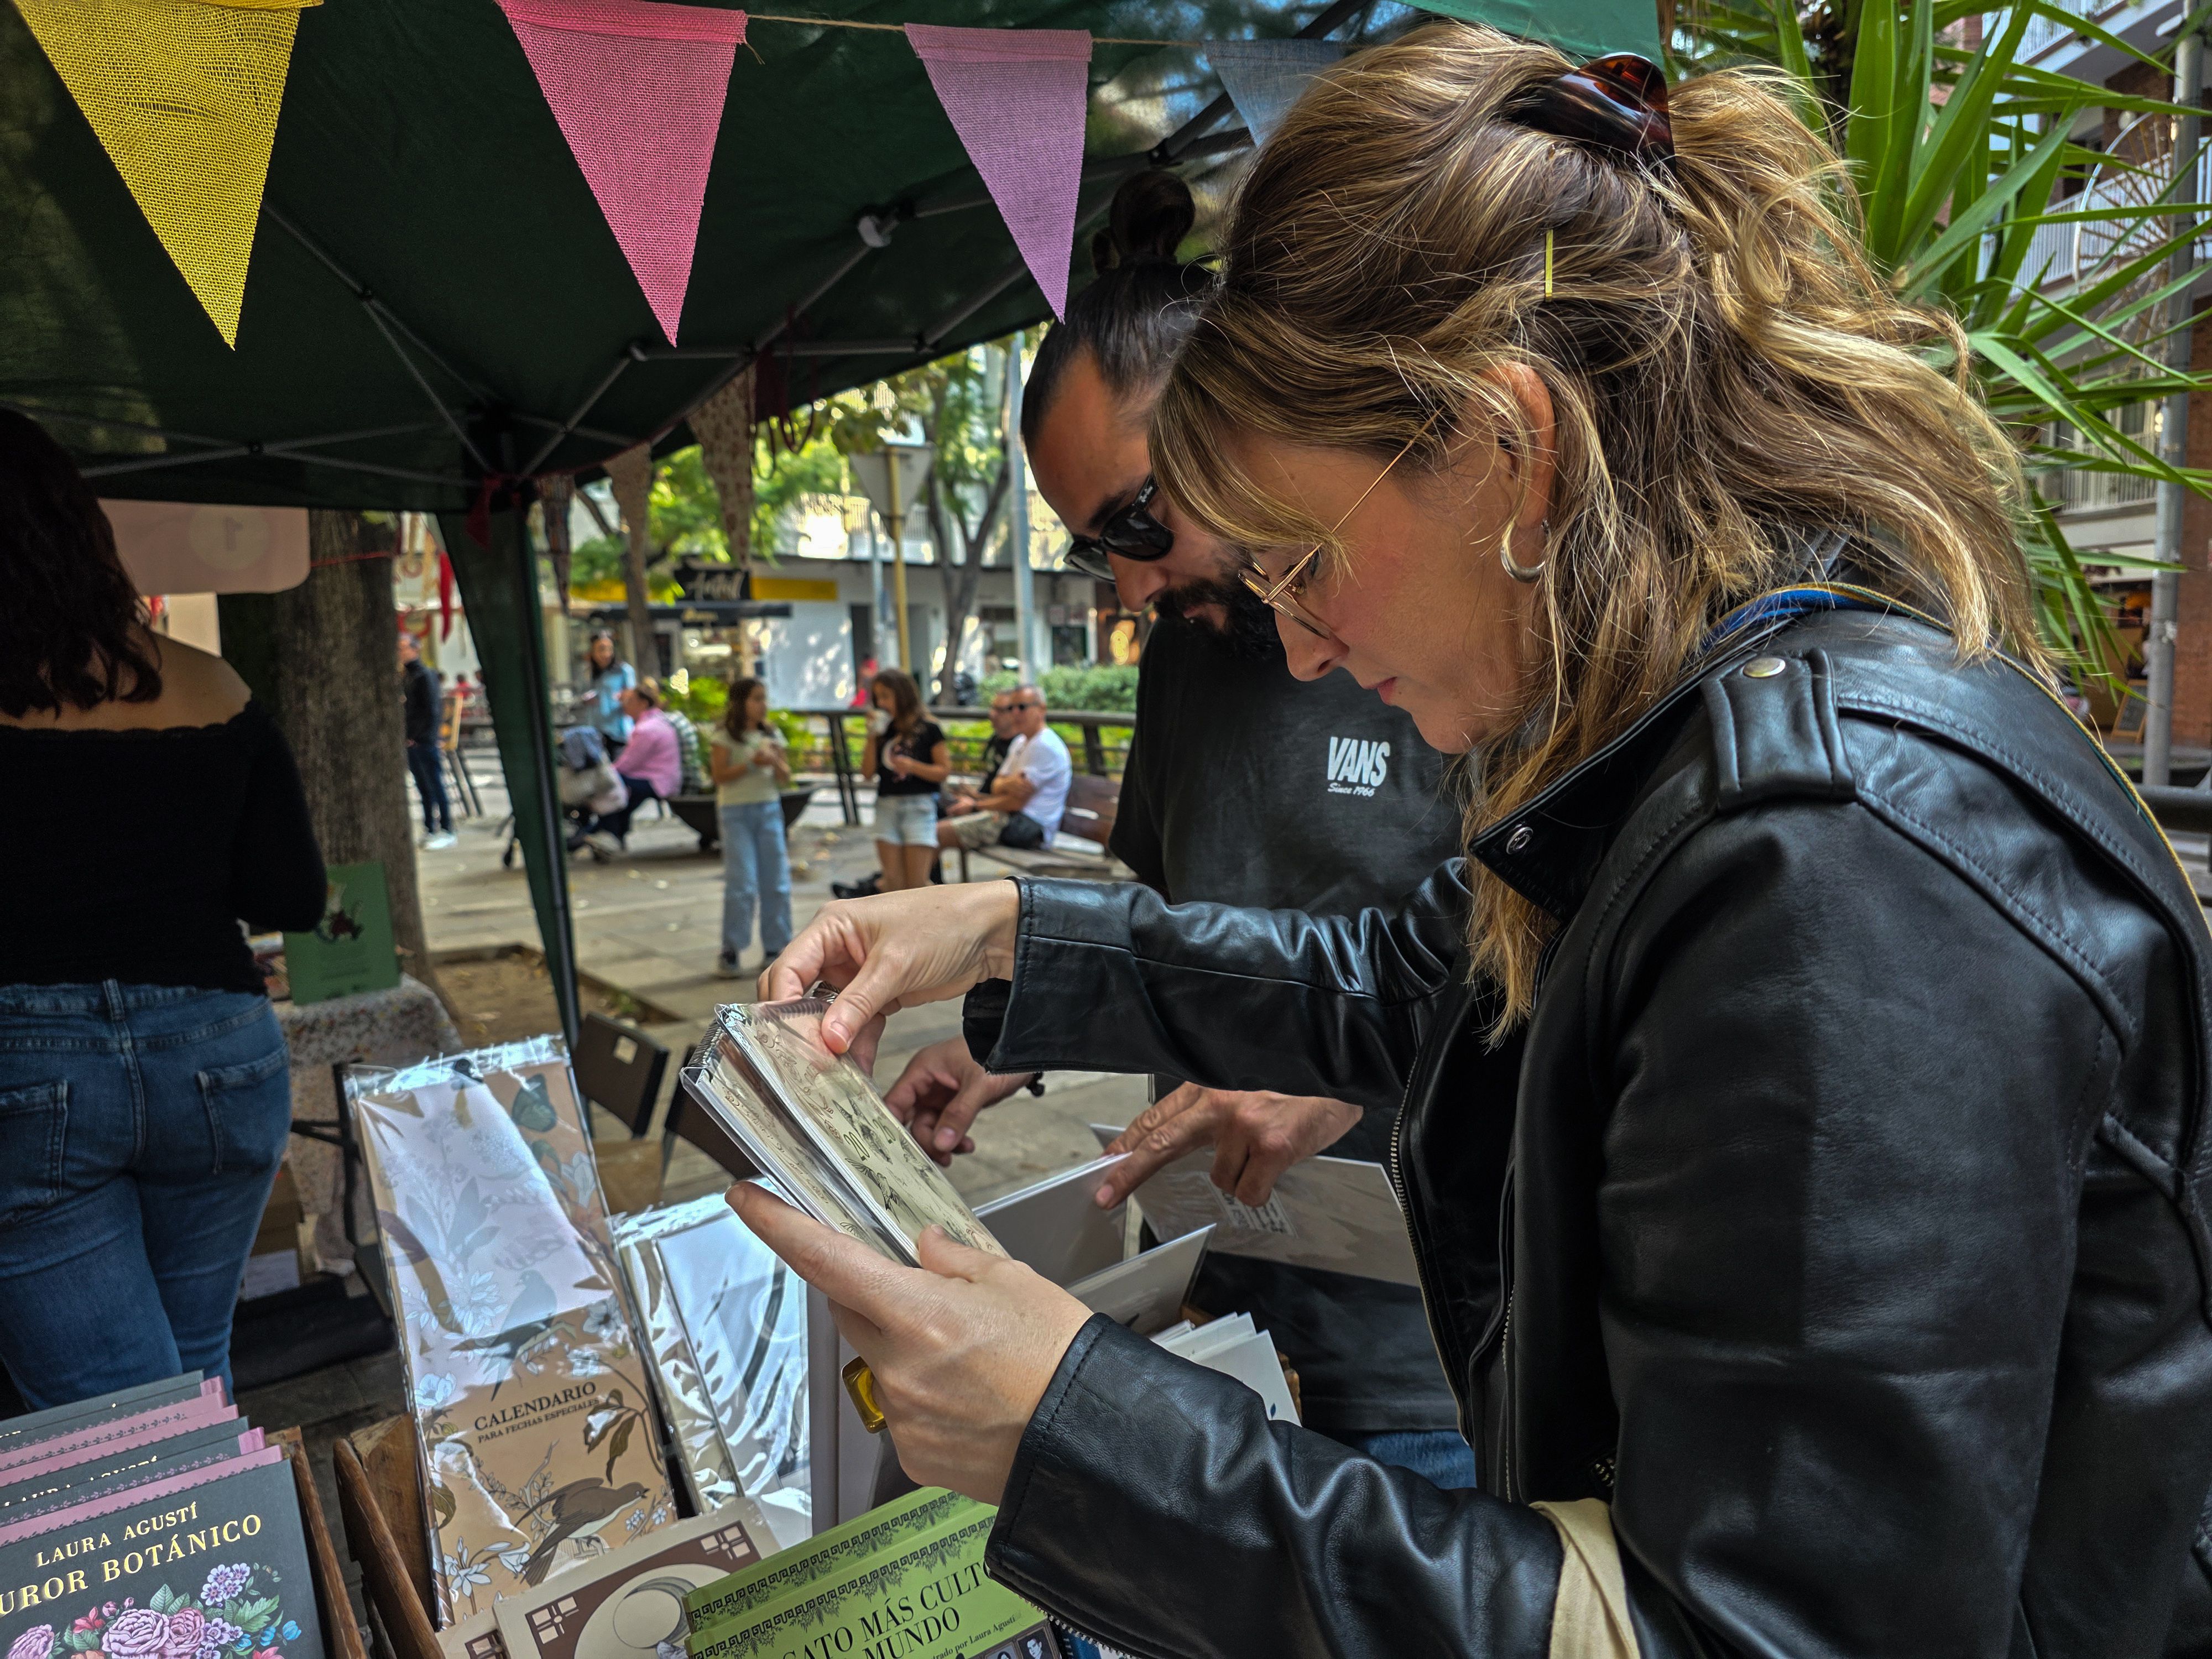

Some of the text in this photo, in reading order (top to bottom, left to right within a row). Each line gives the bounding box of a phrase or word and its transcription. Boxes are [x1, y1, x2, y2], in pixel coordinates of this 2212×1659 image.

[1328, 736, 1390, 787] VANS
[1327, 782, 1375, 797] Since 1966
[474, 1381, 596, 1431] CALENDARIO
[478, 1397, 600, 1443] PARA FECHAS ESPECIALES
[36, 1501, 198, 1568] LAURA AGUSTÍ
[102, 1514, 262, 1582] BOTÁNICO
[858, 1596, 915, 1642] MÁS
[920, 1558, 992, 1610] CULT
[862, 1606, 960, 1659] MUNDO
[955, 1640, 968, 1653] por
[969, 1630, 992, 1644] Laura
[993, 1614, 1016, 1632] Agustí
